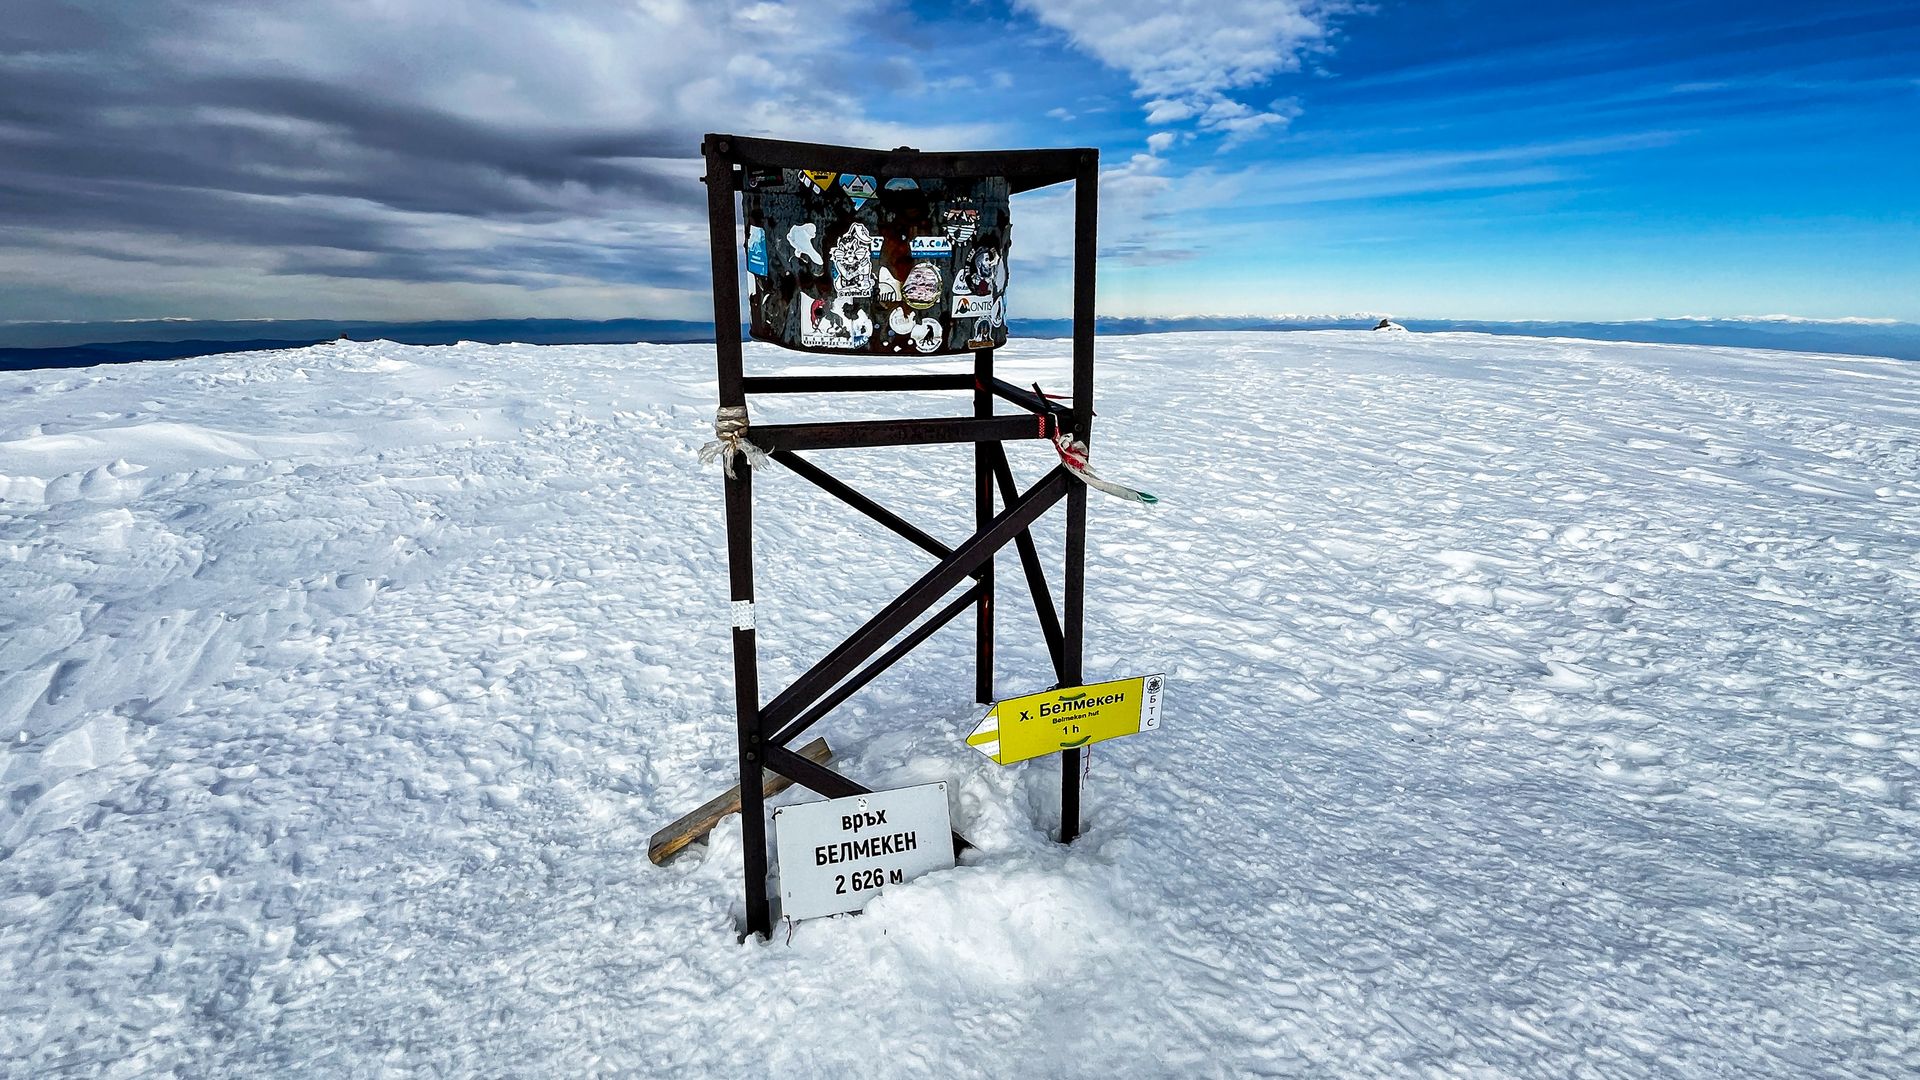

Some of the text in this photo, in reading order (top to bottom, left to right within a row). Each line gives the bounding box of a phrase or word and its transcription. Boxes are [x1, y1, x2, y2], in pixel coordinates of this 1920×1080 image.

[1019, 692, 1125, 722] х. Белмекен
[1052, 710, 1100, 724] Belmeken hut
[1062, 725, 1080, 735] 1 h
[841, 809, 888, 833] връх
[815, 831, 918, 866] БЕЛМЕКЕН
[834, 867, 904, 895] 2 626 м
